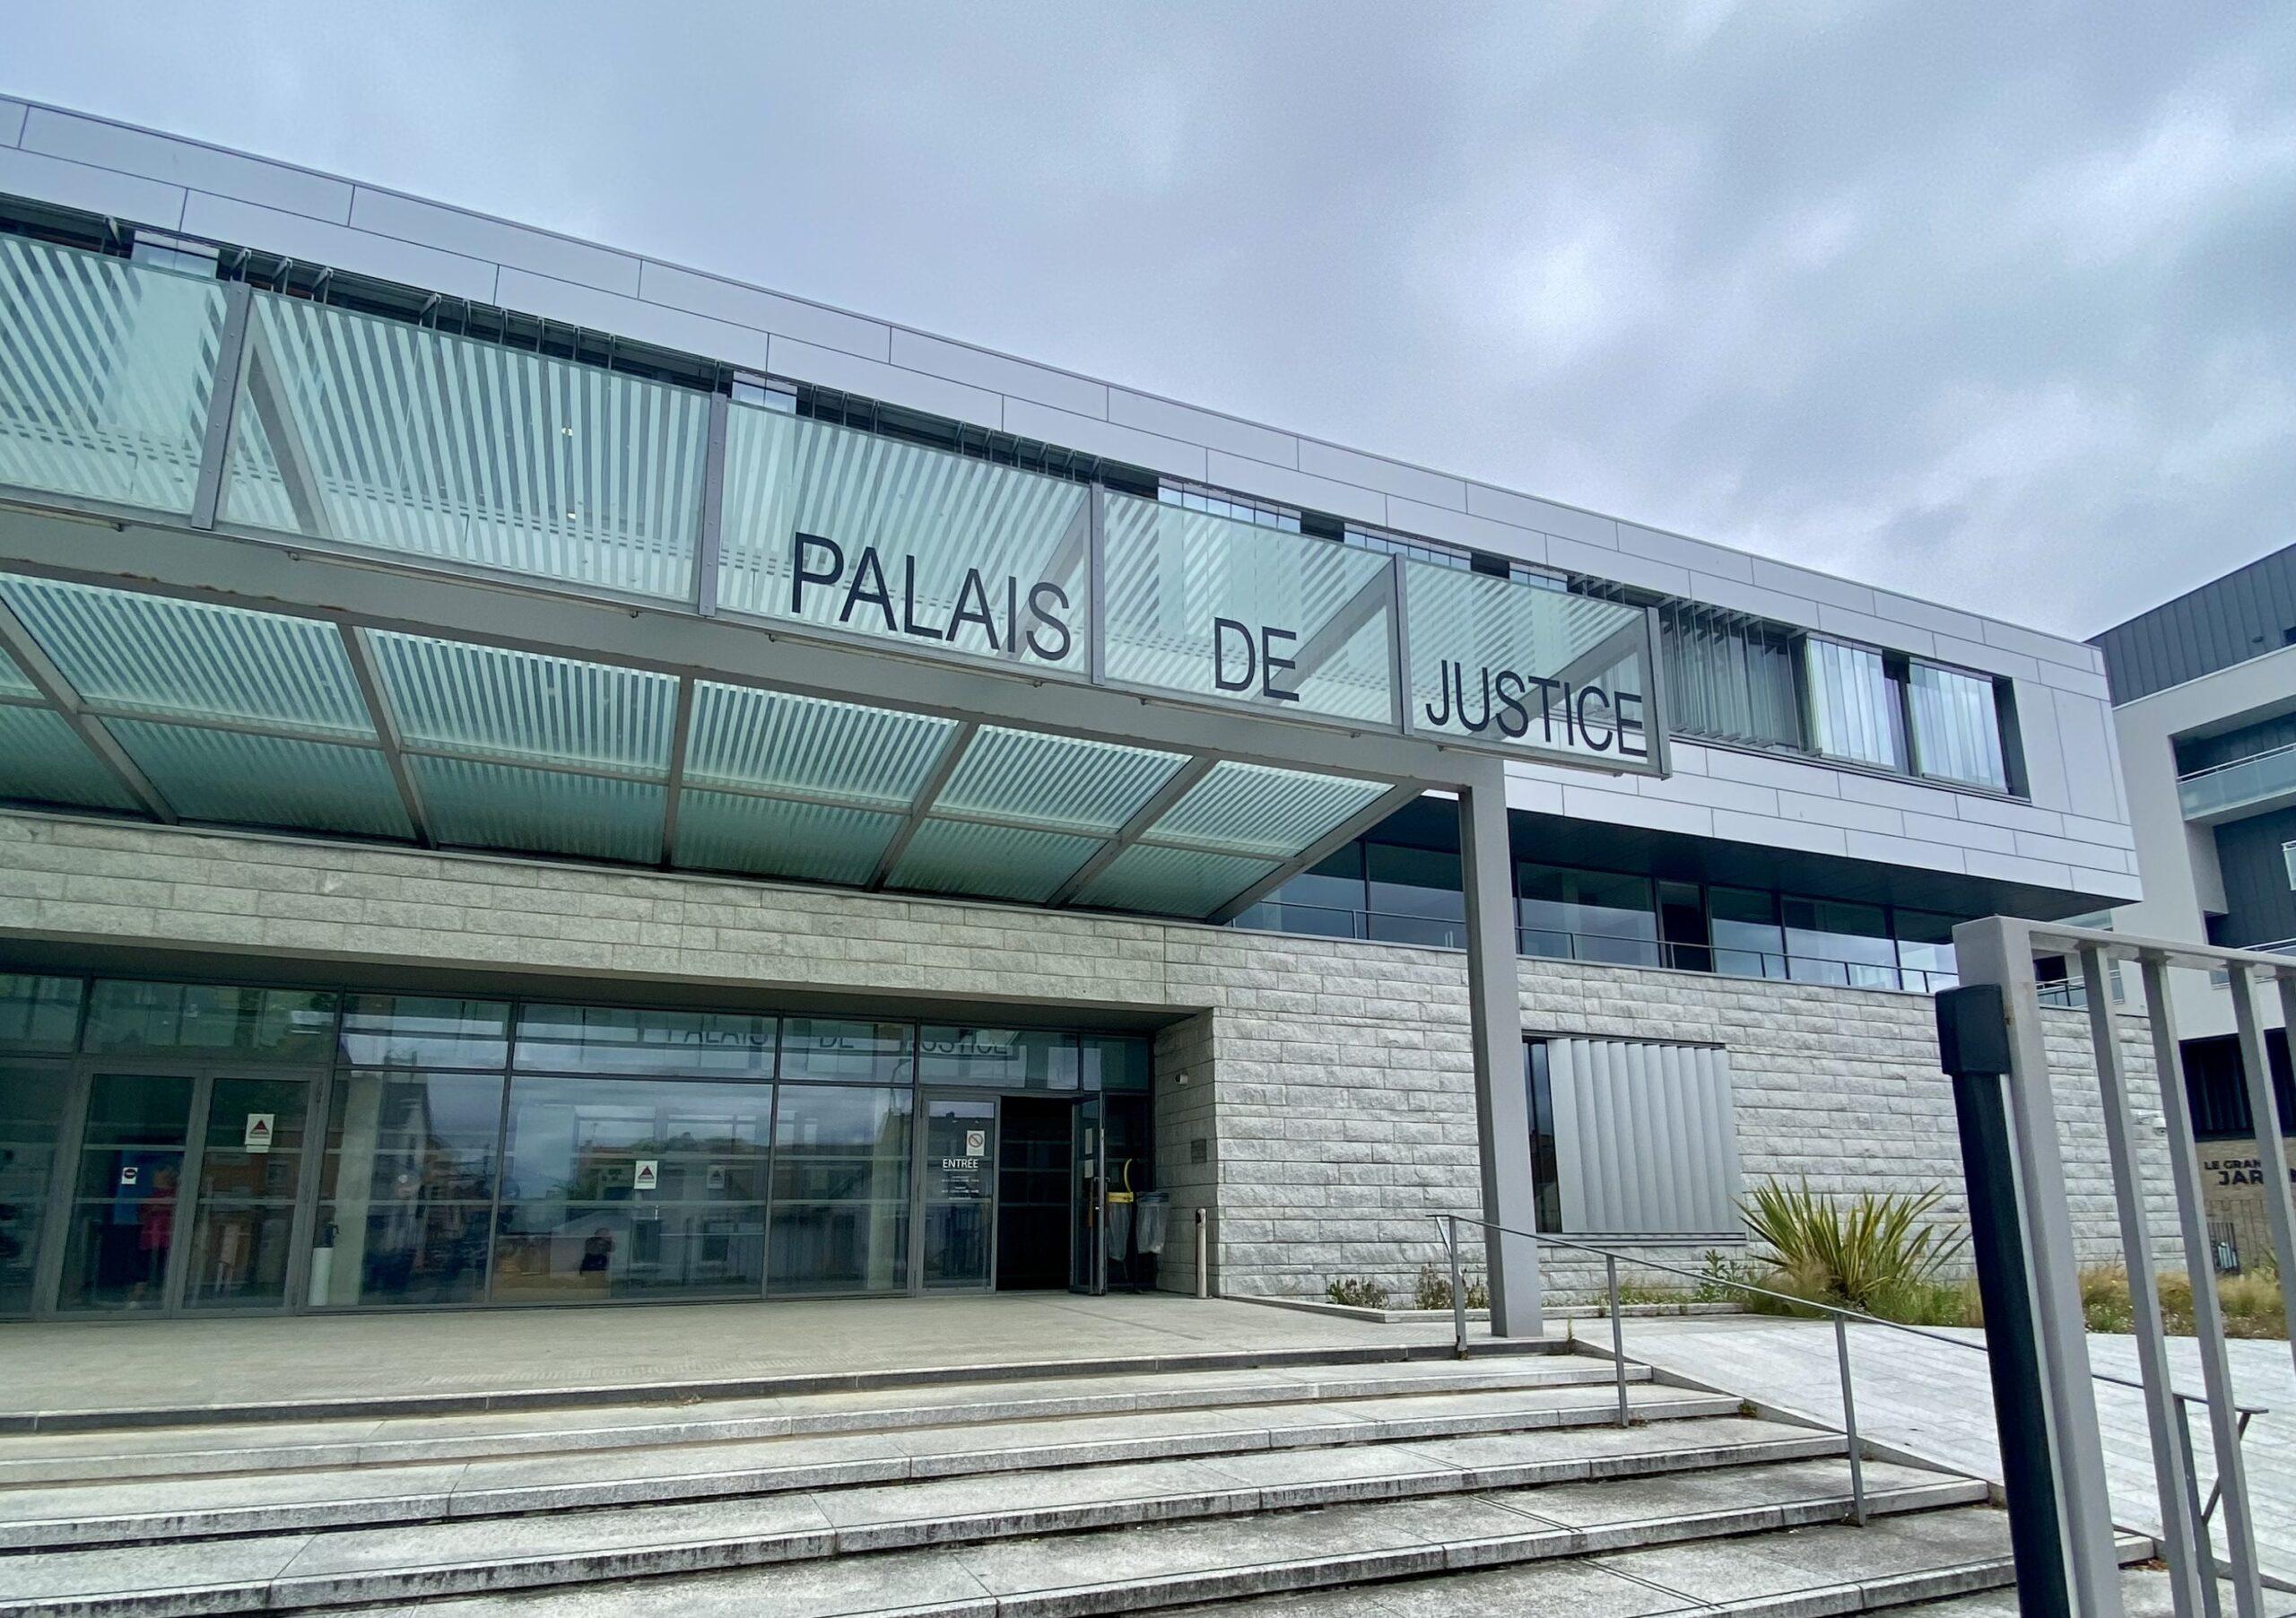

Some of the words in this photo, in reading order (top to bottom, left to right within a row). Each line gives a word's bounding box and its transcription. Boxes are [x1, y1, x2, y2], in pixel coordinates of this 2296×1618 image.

[793, 531, 1070, 661] PALAIS
[1213, 617, 1298, 702] DE
[1427, 659, 1648, 759] JUSTICE
[943, 1157, 978, 1169] ENTRÉE
[2205, 1161, 2220, 1170] LE
[2223, 1160, 2261, 1170] GRAN
